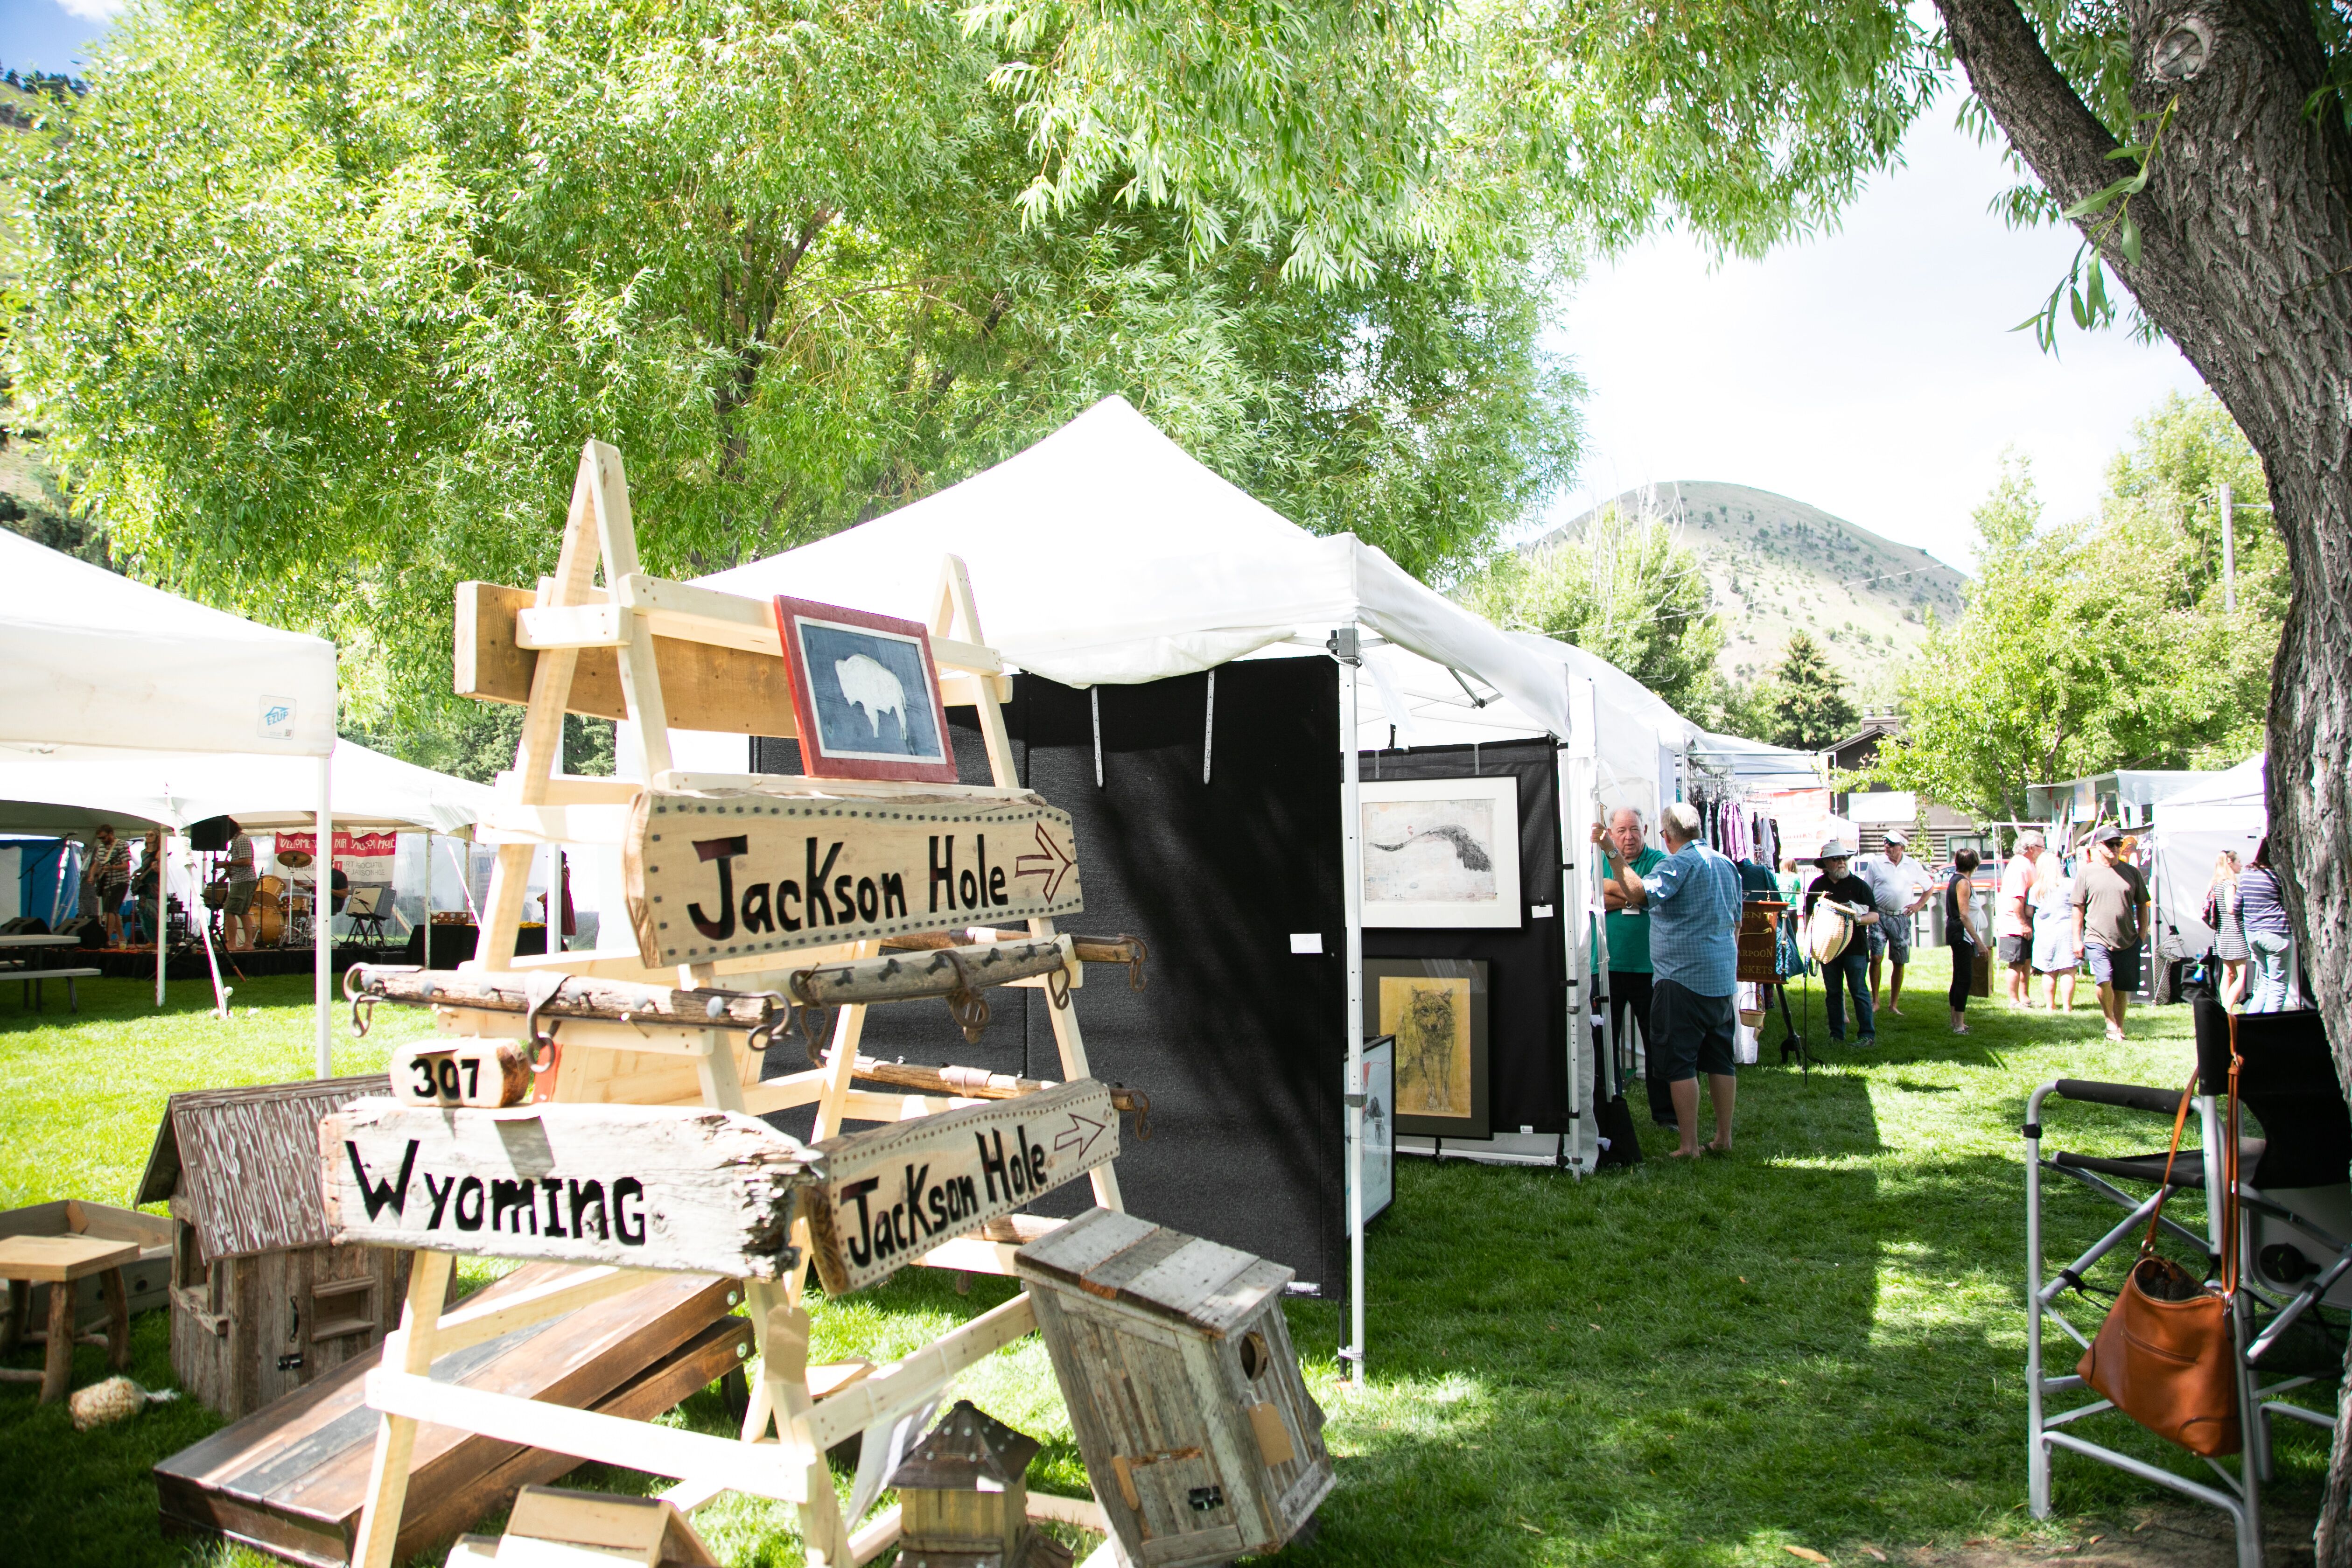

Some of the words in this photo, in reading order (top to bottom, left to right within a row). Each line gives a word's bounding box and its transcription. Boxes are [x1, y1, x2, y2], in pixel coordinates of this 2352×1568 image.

[334, 839, 347, 848] FAIR
[378, 838, 395, 849] HOLE
[687, 834, 908, 940] Jackson
[929, 833, 1008, 913] Hole
[1743, 911, 1773, 921] ENT
[1738, 947, 1773, 958] ARPOON
[1737, 965, 1773, 974] ASKETS
[410, 1057, 480, 1099] 307
[840, 1163, 979, 1268] Jackson
[975, 1125, 1048, 1203] Hole
